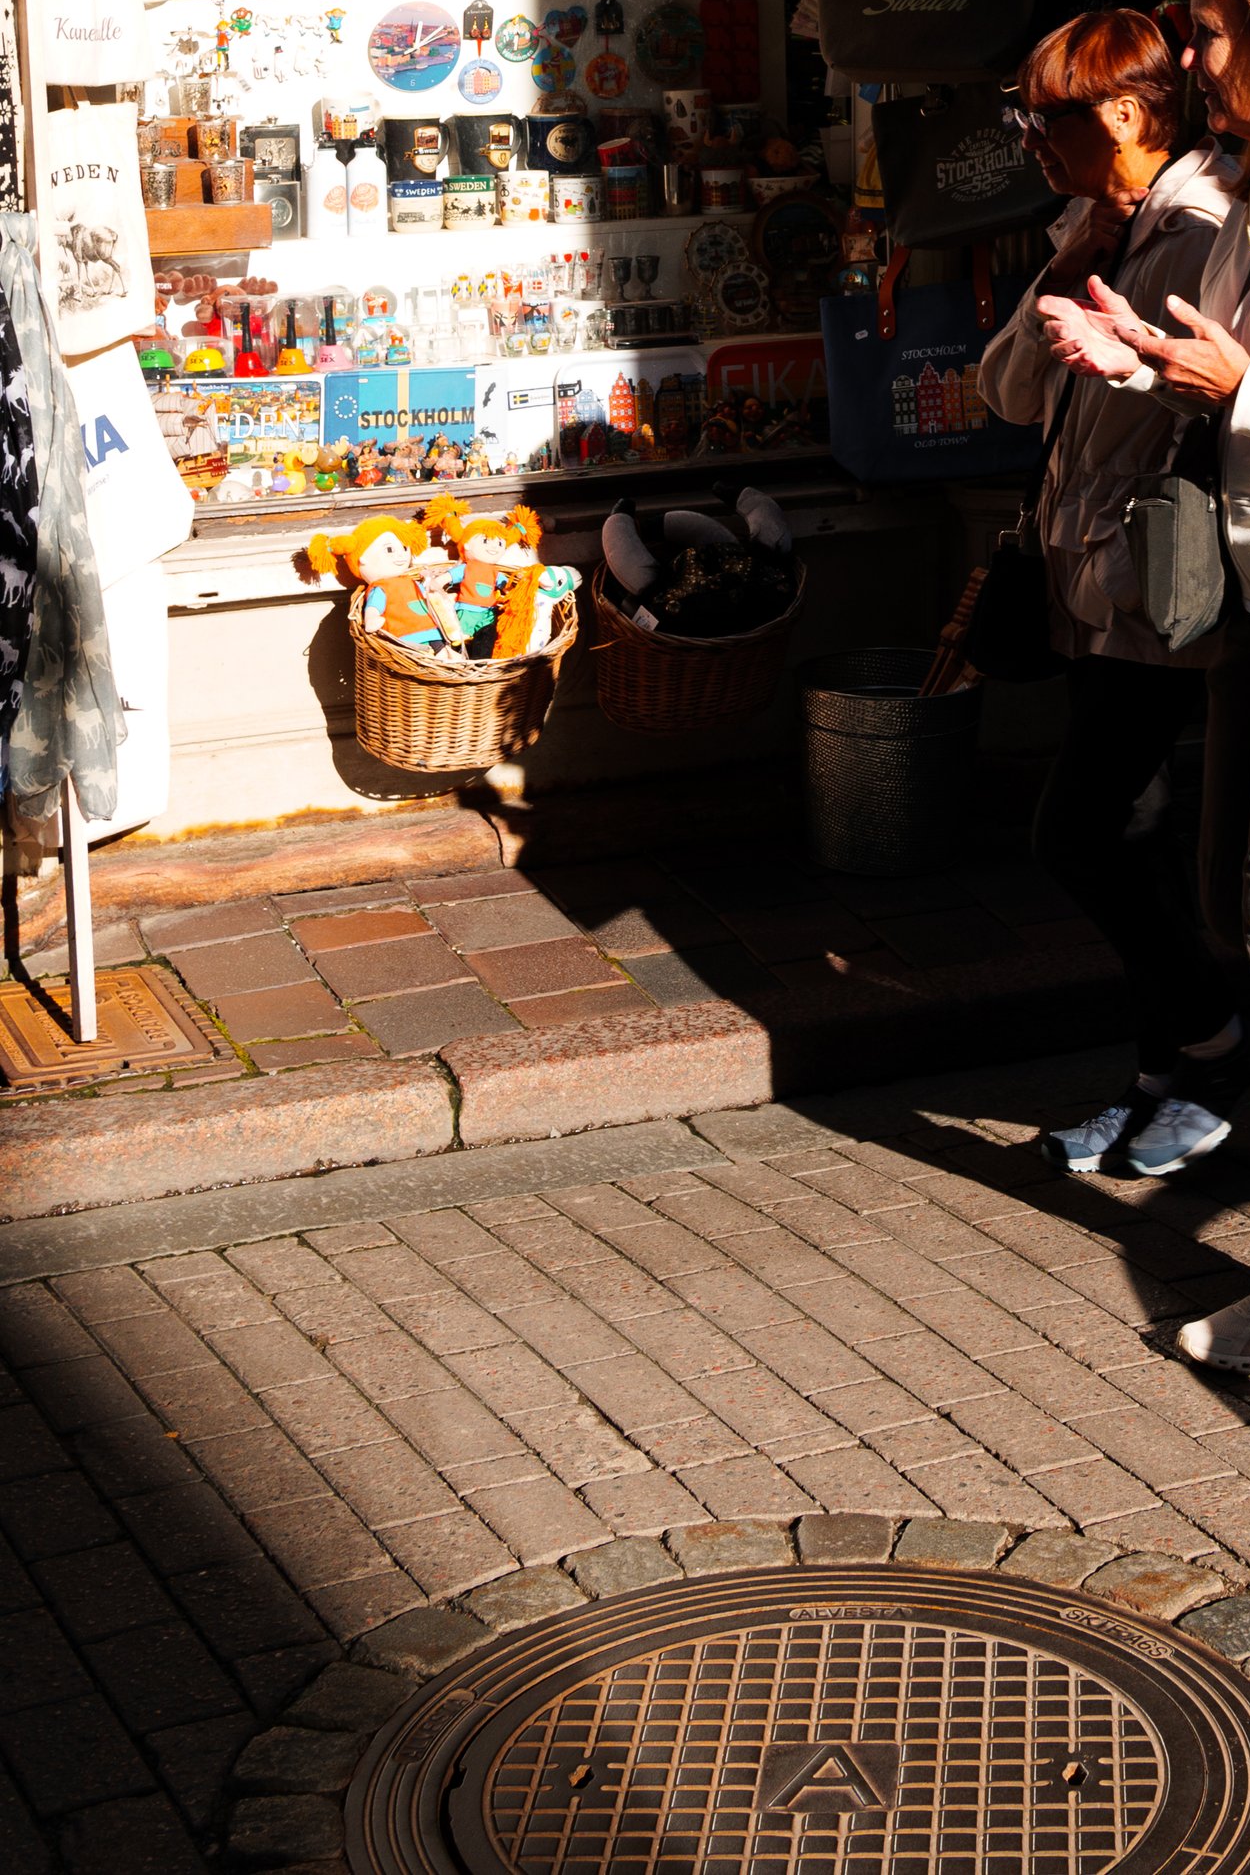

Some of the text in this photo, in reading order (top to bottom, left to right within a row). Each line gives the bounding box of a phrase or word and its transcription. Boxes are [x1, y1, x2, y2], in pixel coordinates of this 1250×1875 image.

[936, 138, 1025, 189] STOCKHOLM
[50, 163, 120, 189] WEDEN
[405, 187, 436, 197] SWEDEN
[449, 182, 487, 192] SWEDEN
[902, 343, 968, 361] STOCKHOLM
[214, 410, 303, 444] EDEN
[360, 406, 476, 431] STOCKHOLM
[914, 435, 971, 449] OLD TOWN
[797, 1606, 907, 1620] ALVESTA
[767, 1742, 883, 1812] A
